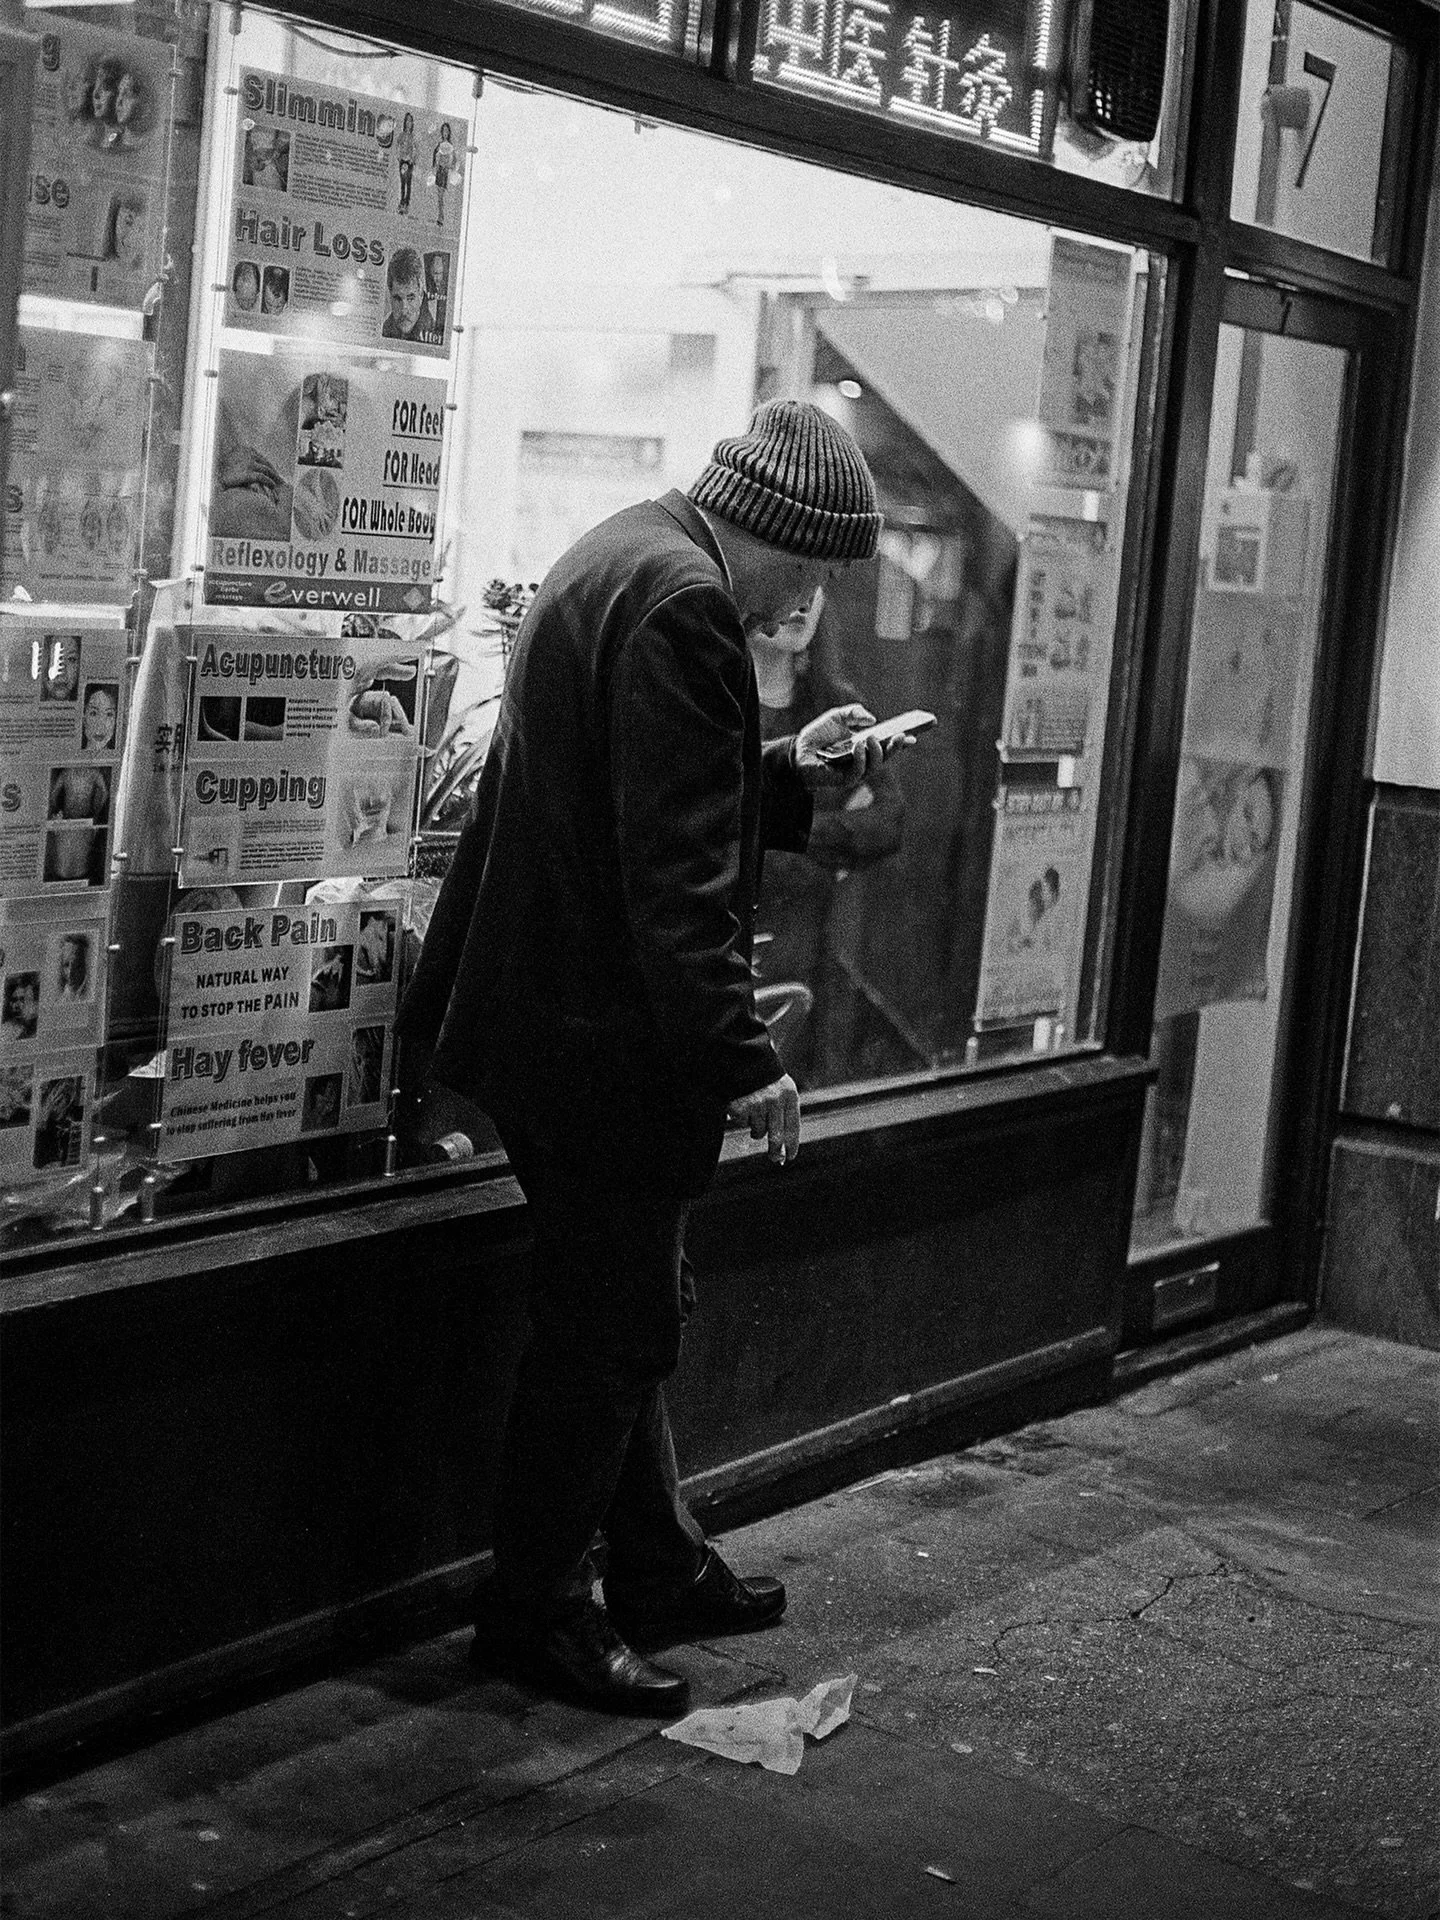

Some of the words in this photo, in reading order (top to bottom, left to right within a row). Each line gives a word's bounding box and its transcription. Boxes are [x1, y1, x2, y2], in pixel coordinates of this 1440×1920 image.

[243, 74, 395, 148] Slimming
[1295, 51, 1337, 189] 7
[234, 208, 307, 251] Hair
[313, 221, 385, 266] Loss
[370, 499, 405, 532] Whole
[211, 537, 329, 577] Reflexology
[334, 547, 347, 572] &
[353, 548, 431, 581] Massage
[200, 643, 356, 685] Acupuncture
[195, 769, 326, 811] Cupping
[181, 915, 265, 954] Back
[270, 912, 337, 947] Pain
[196, 970, 258, 989] NATURAL
[261, 966, 289, 983] WAY
[181, 1005, 198, 1020] TO
[200, 1001, 235, 1019] STOP
[236, 998, 262, 1014] THE
[263, 991, 300, 1011] PAIN
[171, 1047, 234, 1083] Hay
[238, 1039, 315, 1073] fever
[166, 1125, 176, 1136] to
[176, 1121, 197, 1136] stop
[197, 1115, 238, 1131] suffering
[238, 1114, 259, 1127] from
[259, 1110, 275, 1123] Hay
[275, 1107, 297, 1120] fever
[170, 1104, 208, 1118] Chinese
[209, 1098, 252, 1113] Medicine
[253, 1093, 278, 1107] helps
[279, 1091, 297, 1103] you
